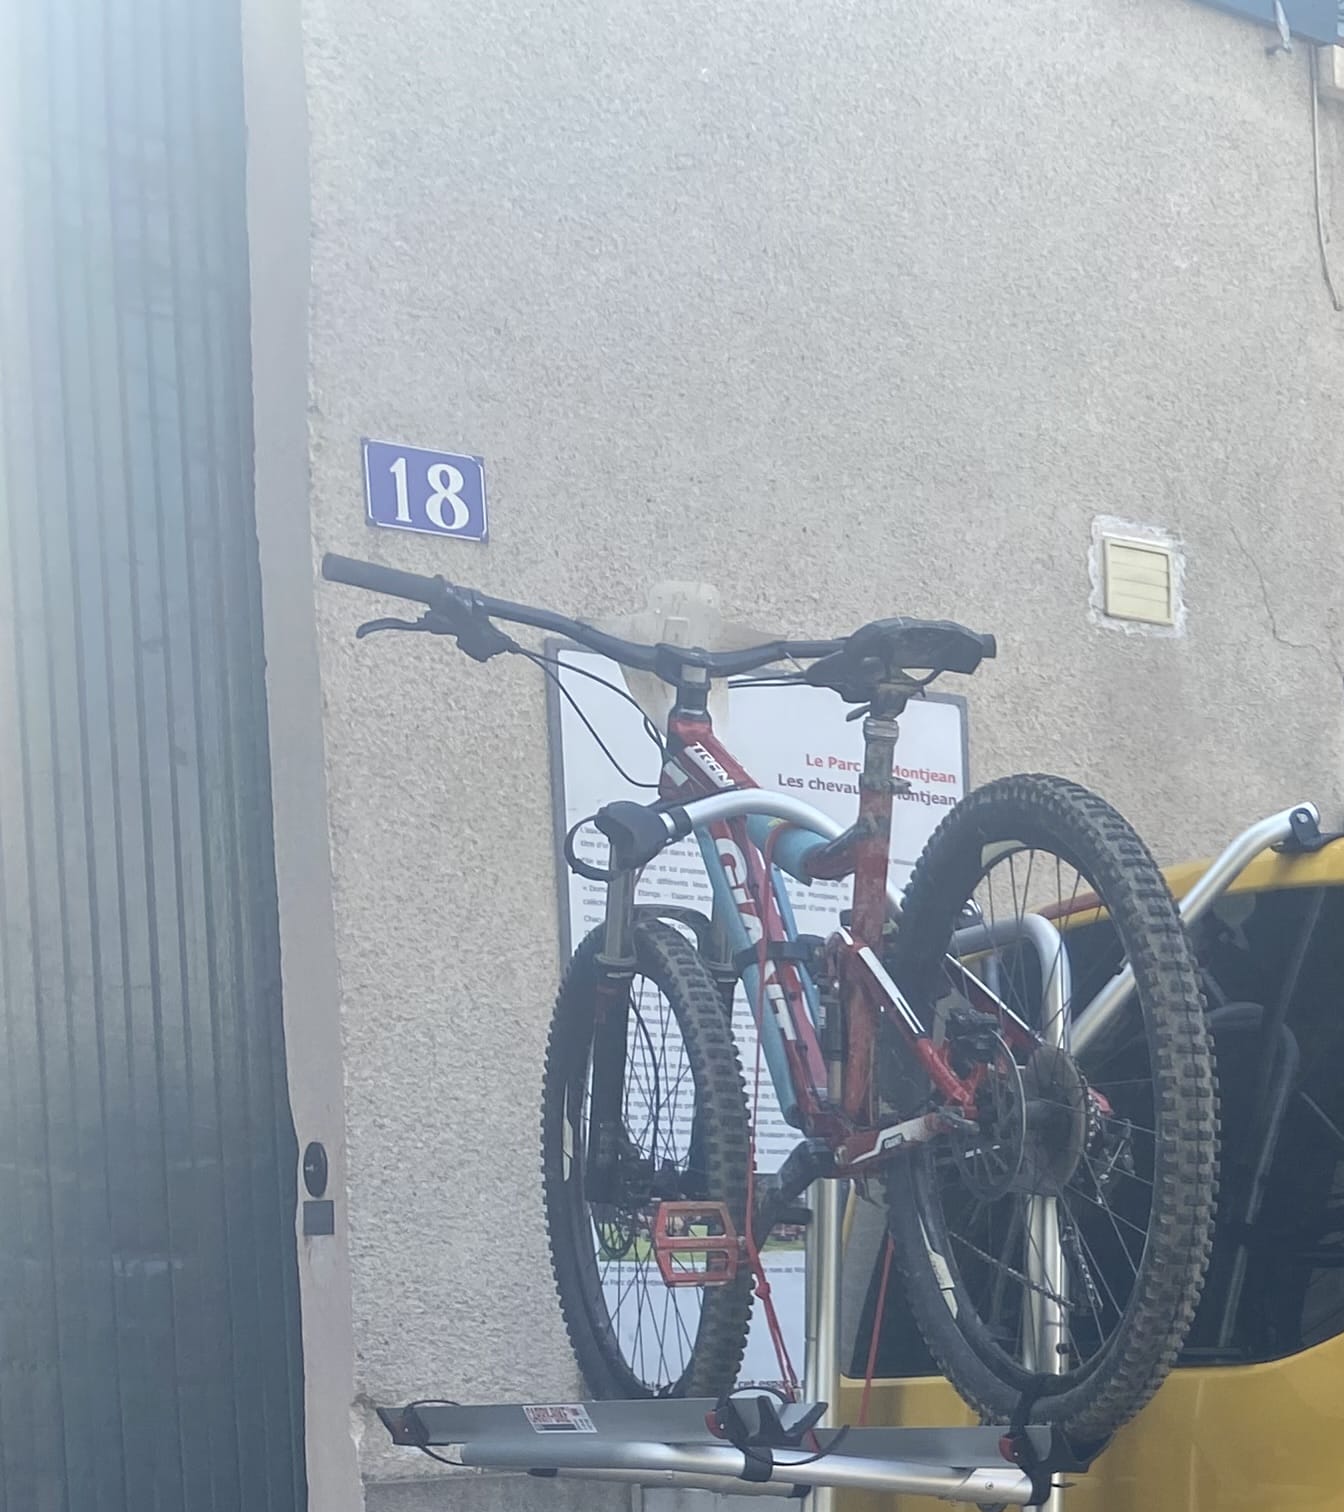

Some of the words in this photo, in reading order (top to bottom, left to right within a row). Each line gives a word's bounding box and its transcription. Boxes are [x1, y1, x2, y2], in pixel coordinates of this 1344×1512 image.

[389, 457, 470, 530] 18
[805, 753, 823, 768] Le
[828, 756, 861, 772] Parc
[778, 773, 803, 789] Les
[808, 777, 860, 796] chevau
